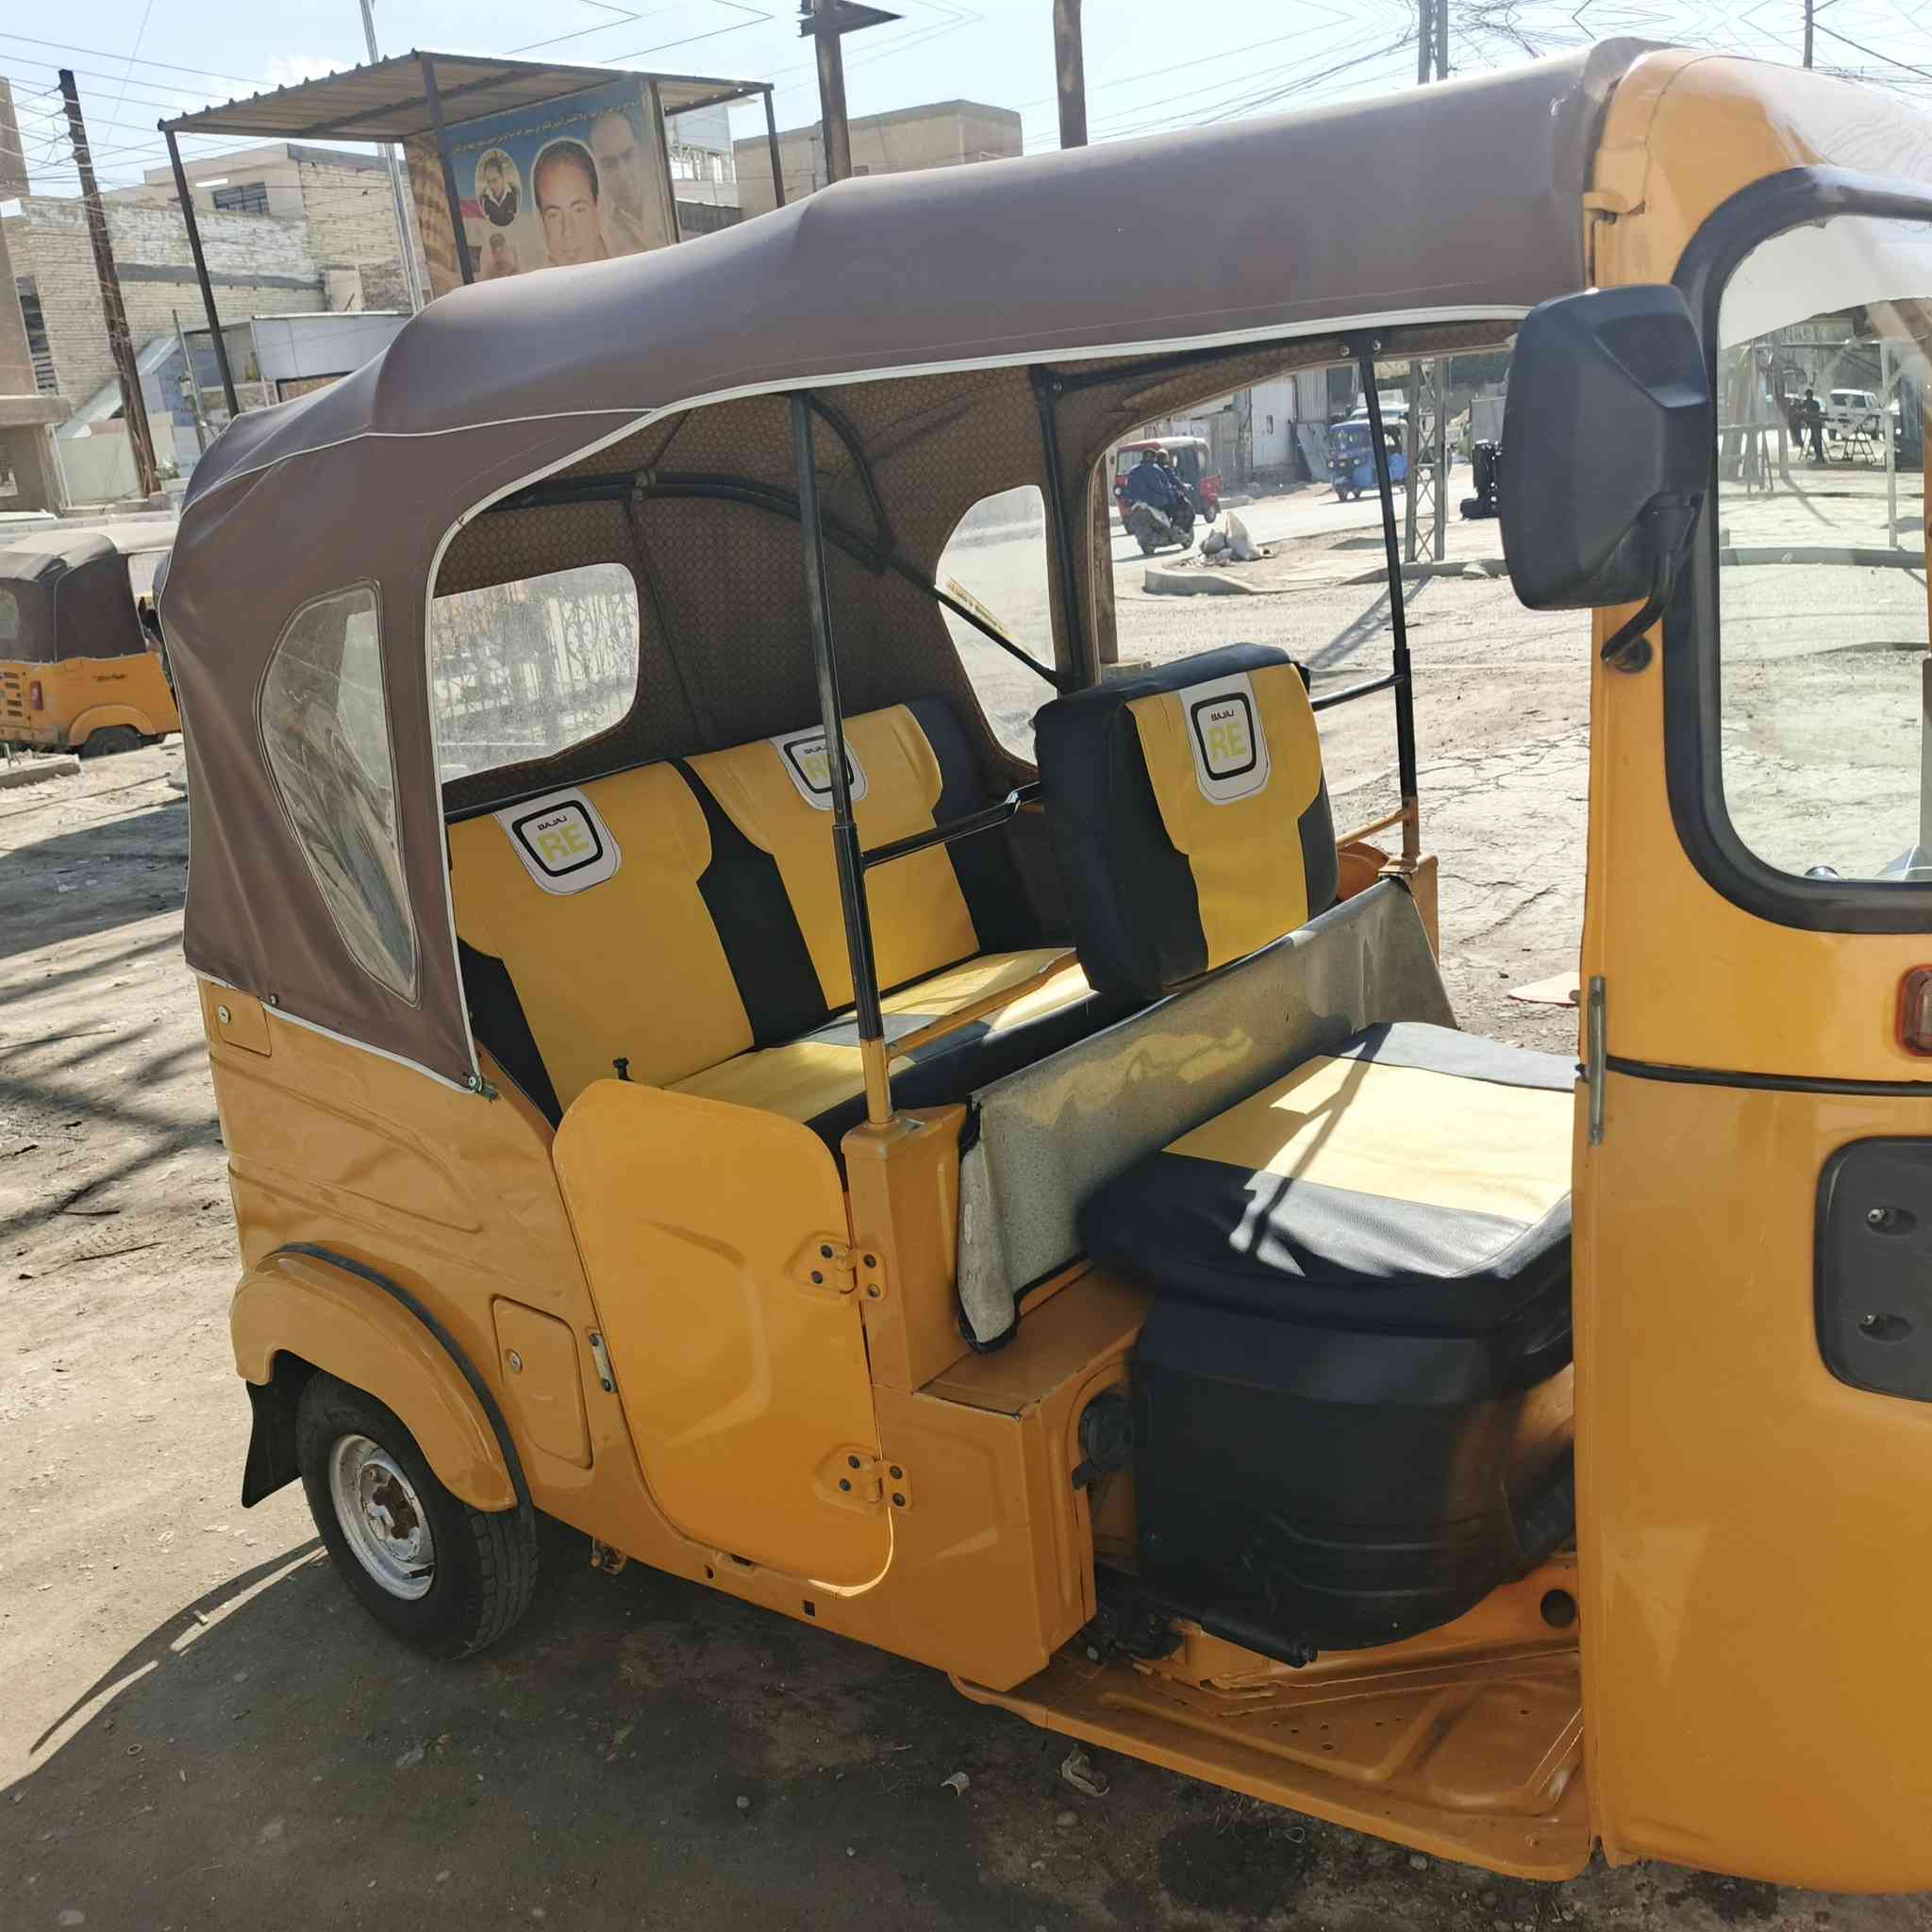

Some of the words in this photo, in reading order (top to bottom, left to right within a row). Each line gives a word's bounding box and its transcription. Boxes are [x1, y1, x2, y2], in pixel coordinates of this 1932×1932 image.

[1210, 709, 1234, 722] BAJAJ
[1208, 724, 1246, 762] RE
[537, 815, 567, 831] BAJAJ
[537, 824, 590, 862] RE
